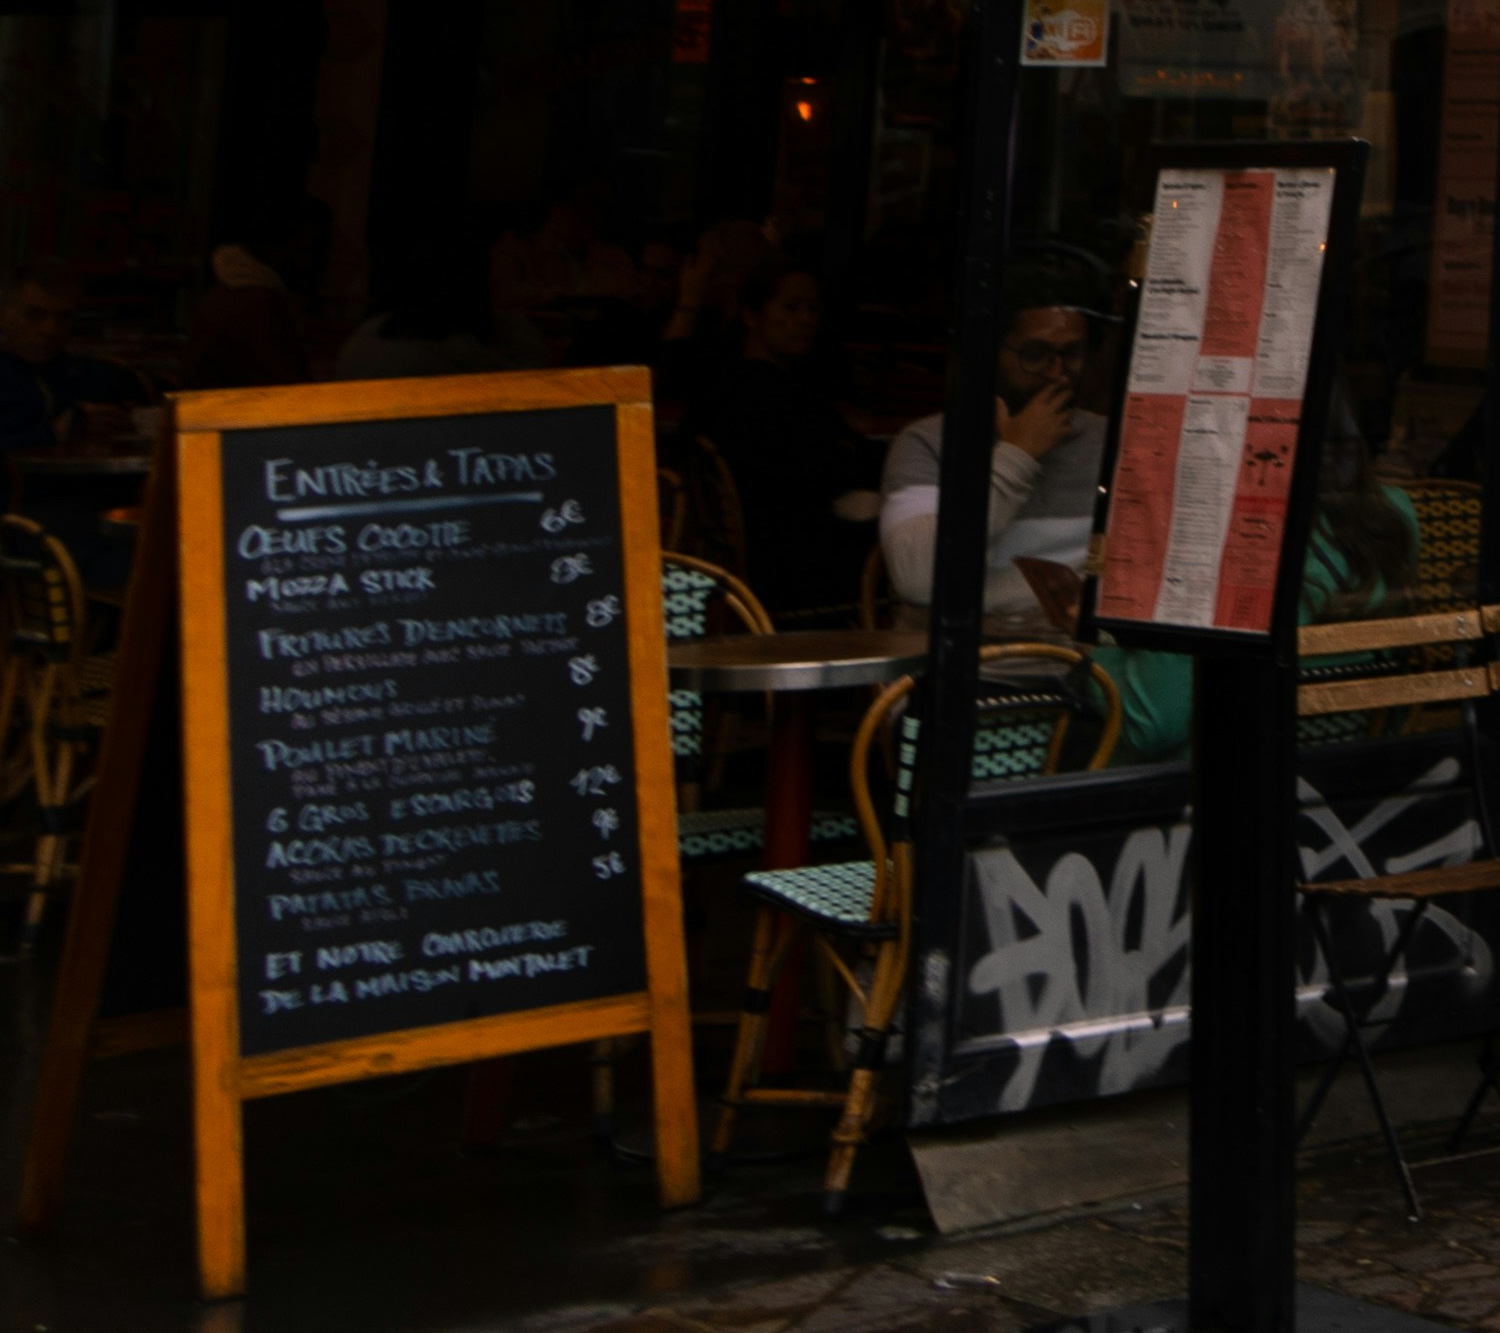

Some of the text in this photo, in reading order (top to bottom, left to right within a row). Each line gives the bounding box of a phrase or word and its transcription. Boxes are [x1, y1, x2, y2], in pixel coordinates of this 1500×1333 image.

[448, 446, 558, 487] TAPAS
[539, 497, 587, 533] 6€
[245, 571, 351, 603] MOZZA
[266, 806, 290, 833] 6
[298, 801, 371, 834] GROS
[265, 951, 304, 981] ET
[316, 938, 406, 972] NOTRE
[309, 979, 349, 1006] LA
